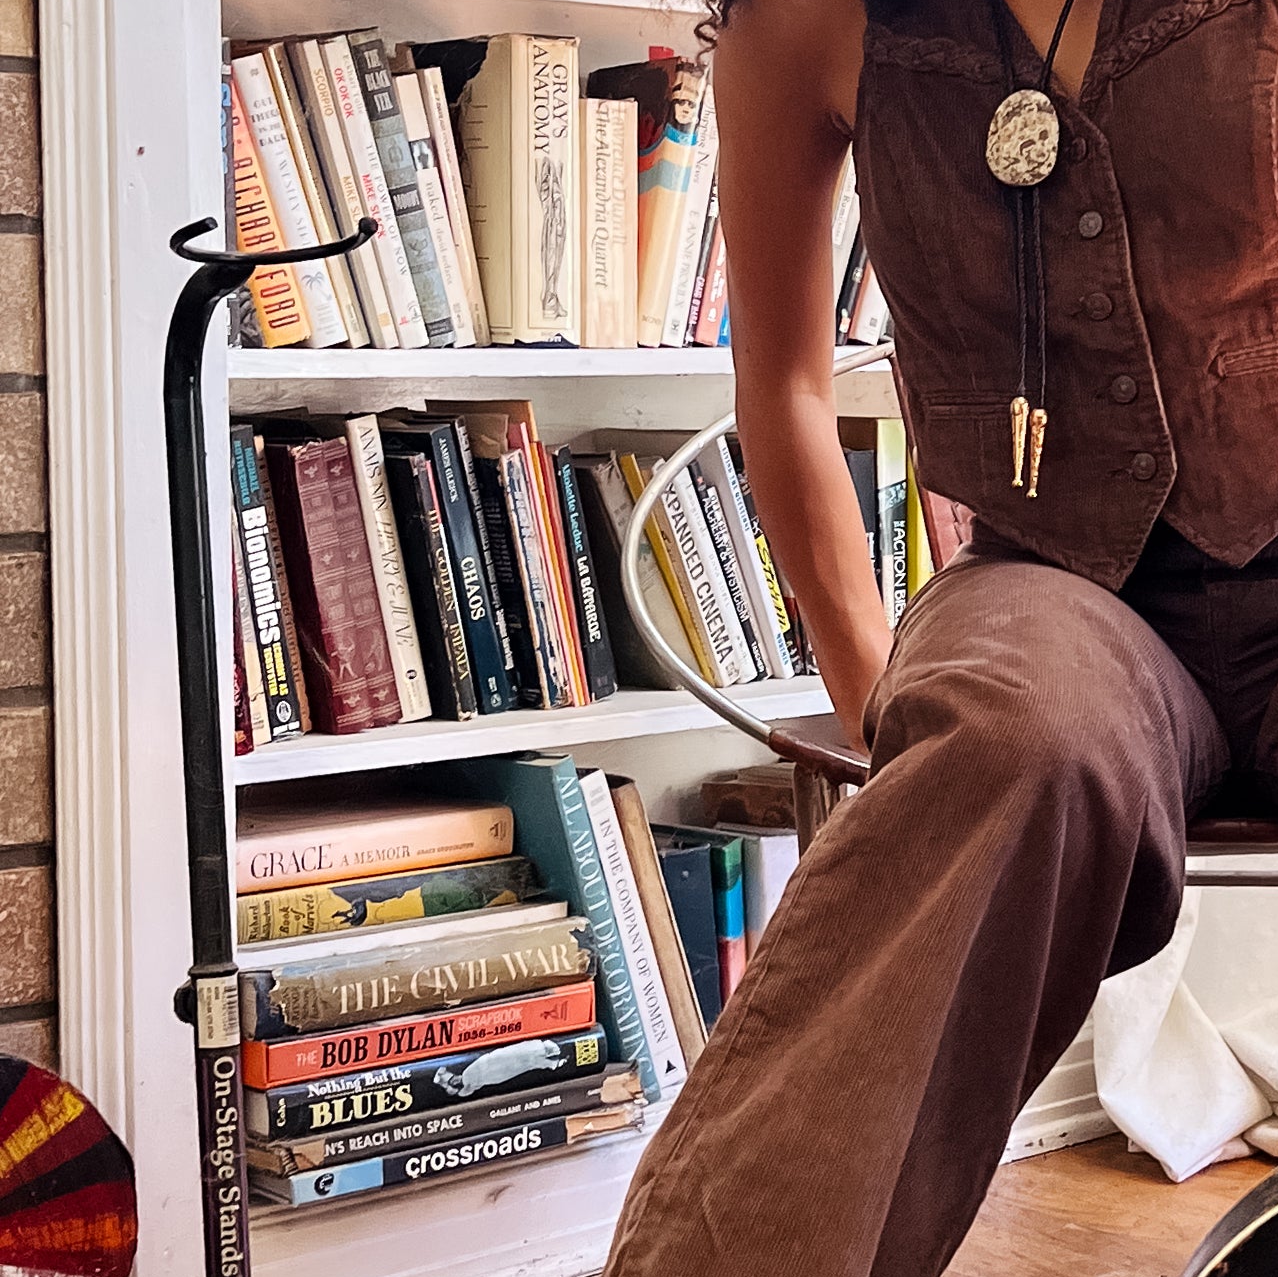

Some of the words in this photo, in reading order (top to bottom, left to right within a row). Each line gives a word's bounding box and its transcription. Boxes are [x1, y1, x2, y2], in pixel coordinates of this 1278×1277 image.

[313, 68, 335, 117] SCORPIO
[334, 67, 345, 83] OK
[339, 85, 350, 102] OK
[533, 43, 550, 154] ANATOMY
[343, 102, 355, 120] OK
[552, 63, 568, 139] GRAY'S
[361, 173, 374, 201] MIKE
[595, 135, 611, 223] Alexandria
[693, 151, 710, 185] News
[374, 175, 394, 222] POWER
[394, 246, 408, 276] NOW
[425, 181, 445, 222] naked
[591, 226, 610, 288] Quartet
[255, 269, 300, 329] FORD
[439, 437, 451, 468] JAMES
[562, 463, 577, 512] Violette
[569, 512, 584, 553] Leduc
[241, 505, 282, 645] Bionomics
[577, 555, 590, 577] LA
[662, 482, 705, 580] XPANDED
[696, 581, 734, 664] CINEMA
[700, 496, 727, 549] ALCHEMY
[720, 560, 752, 623] MYSTICISM
[893, 527, 906, 589] ACTION
[435, 546, 456, 612] GOLDEN
[450, 623, 470, 680] IMPALA
[460, 556, 486, 621] CHAOS
[389, 600, 414, 648] JUNE
[555, 775, 583, 826] ALL
[600, 818, 612, 839] IN
[250, 844, 333, 879] GRACE
[340, 854, 349, 867] A
[354, 845, 411, 864] MEMOIR
[568, 829, 610, 912] ABOUT
[605, 839, 623, 876] THE
[248, 904, 258, 941] Richard
[279, 905, 290, 934] Book
[290, 907, 306, 921] of
[302, 893, 315, 935] Marvels
[615, 877, 645, 954] COMPANY
[332, 974, 402, 1016] THE
[409, 956, 499, 1001] CIVIL
[501, 942, 574, 982] WAR
[635, 957, 651, 976] OF
[458, 1007, 523, 1031] SCRAPBOOK
[592, 918, 653, 1074] DECORATING
[642, 980, 669, 1044] WOMEN
[295, 1048, 319, 1068] THE
[320, 1037, 368, 1069] BOB
[376, 1019, 456, 1059] DYLAN
[307, 1077, 362, 1099] Nothing
[364, 1069, 387, 1087] But
[386, 1065, 412, 1081] the
[308, 1083, 414, 1129] BLUES
[523, 1098, 541, 1112] AND
[210, 1055, 238, 1180] On-Stage
[349, 1131, 390, 1152] REACH
[393, 1123, 423, 1142] INTO
[427, 1114, 464, 1134] SPACE
[405, 1126, 542, 1177] crossroads
[218, 1185, 244, 1277] Stands
